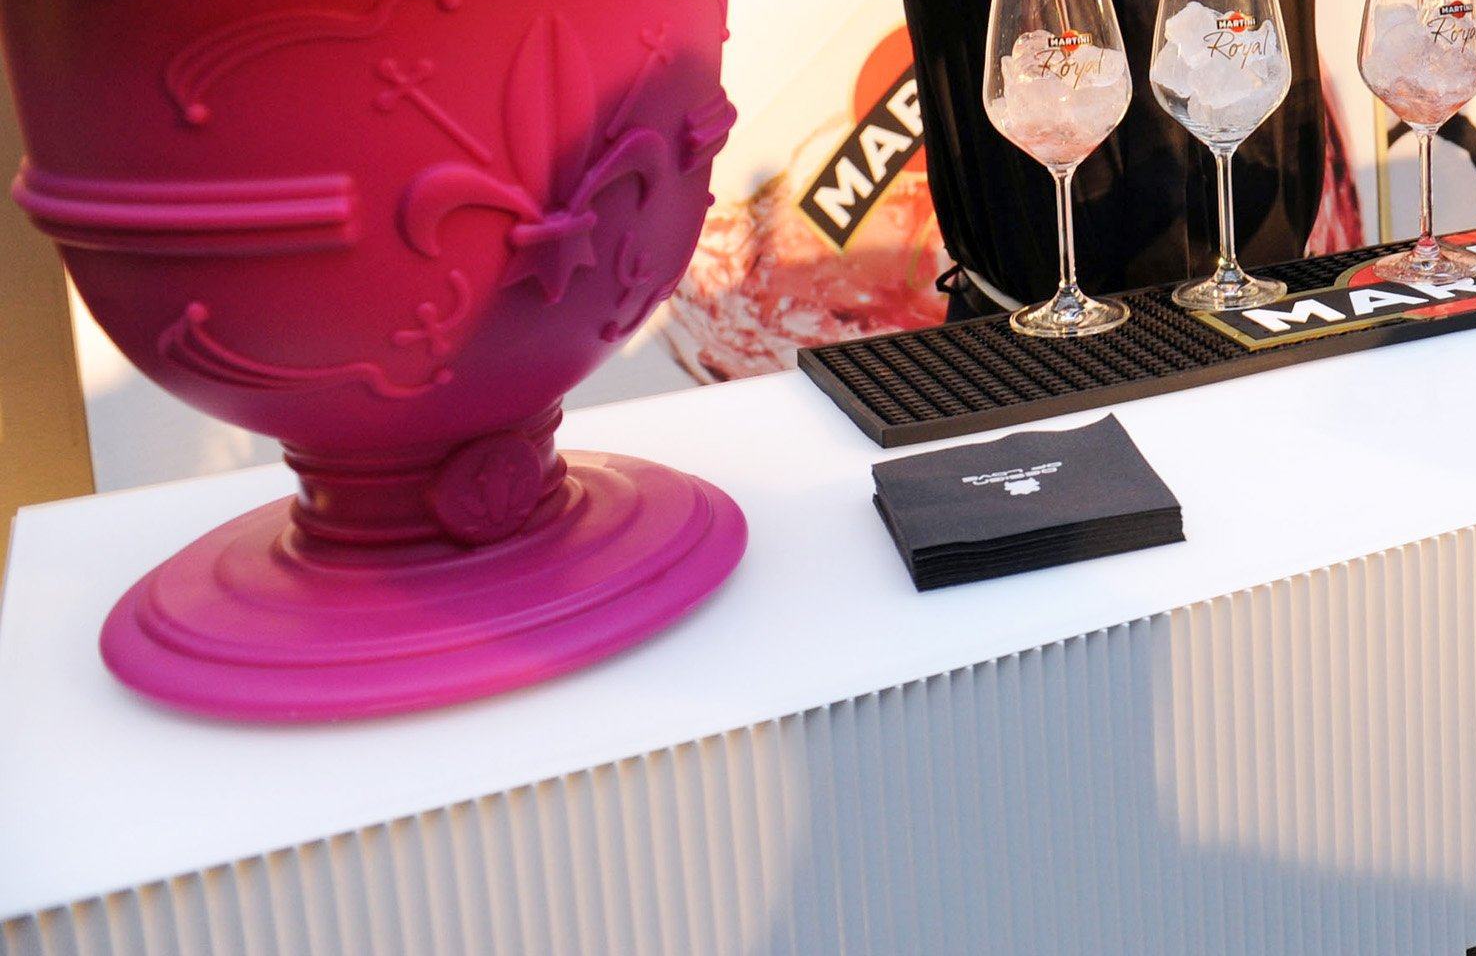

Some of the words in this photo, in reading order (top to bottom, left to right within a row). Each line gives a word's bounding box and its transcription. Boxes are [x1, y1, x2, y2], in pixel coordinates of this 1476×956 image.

[1218, 17, 1256, 29] MARTINI
[1050, 35, 1091, 47] MARTINI
[1203, 30, 1269, 70] Royal
[1034, 49, 1104, 89] Royal
